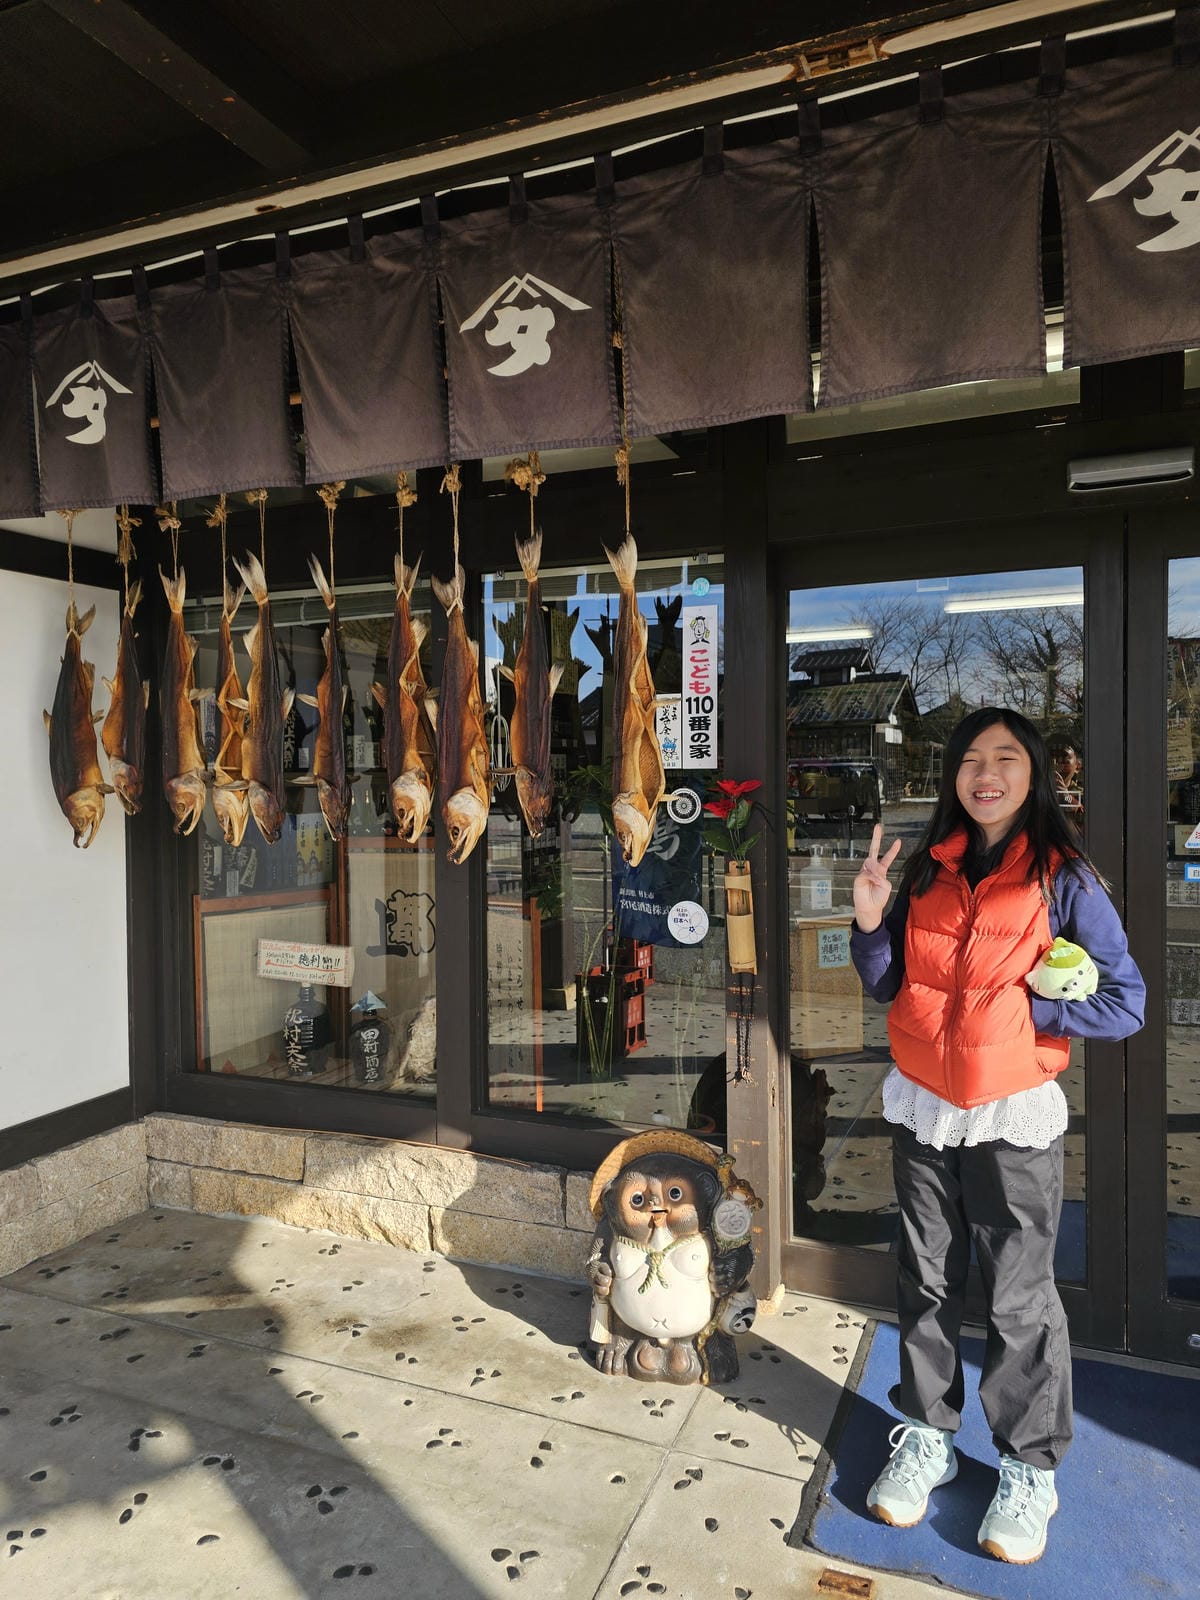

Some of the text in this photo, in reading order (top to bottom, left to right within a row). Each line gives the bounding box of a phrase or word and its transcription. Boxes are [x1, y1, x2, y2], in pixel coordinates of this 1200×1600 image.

[686, 648, 713, 760] こども110番の家
